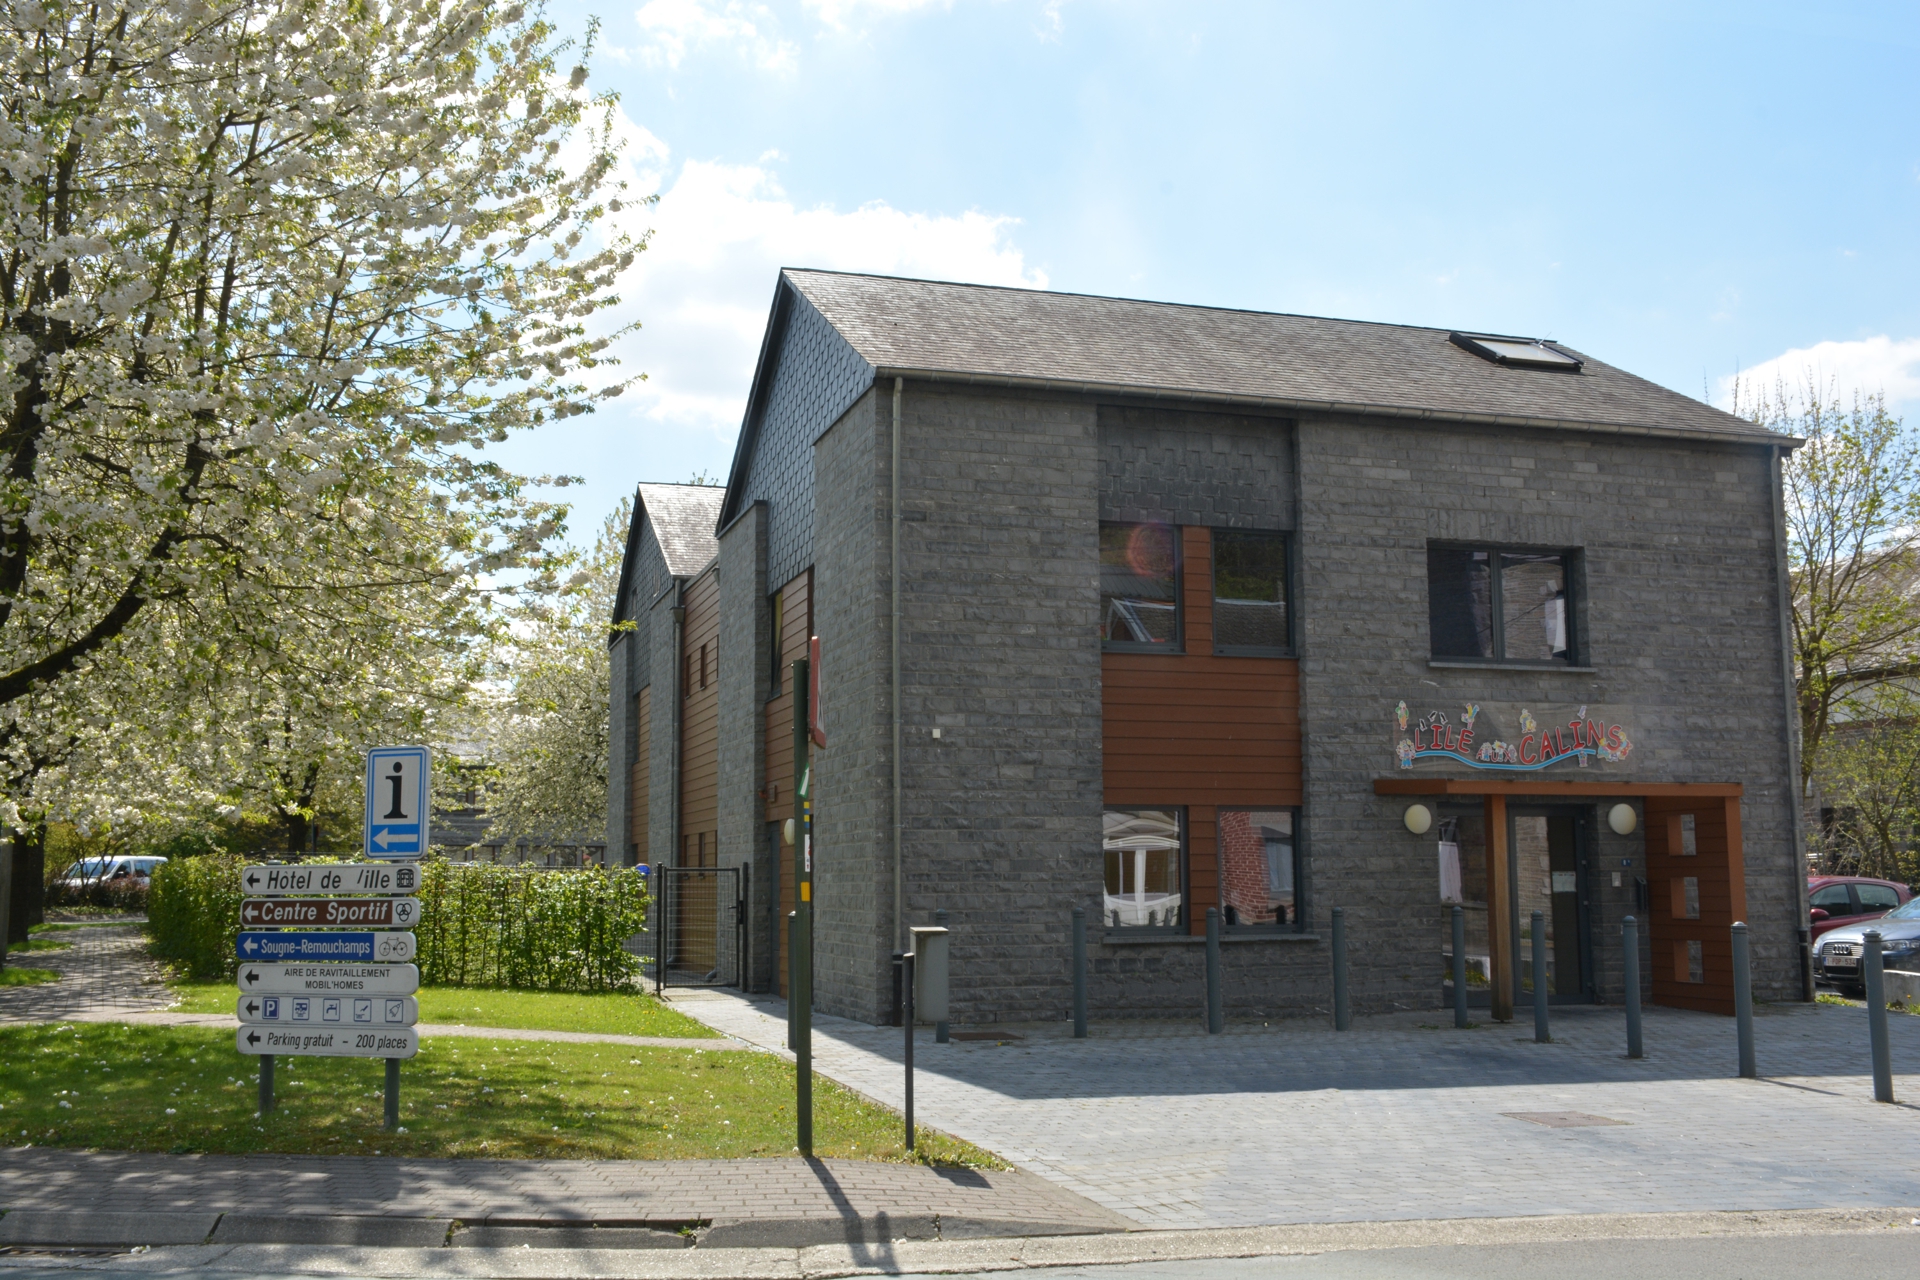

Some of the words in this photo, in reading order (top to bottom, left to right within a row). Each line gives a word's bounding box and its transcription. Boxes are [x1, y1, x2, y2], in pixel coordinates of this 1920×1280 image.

[1519, 719, 1622, 765] CALINS
[267, 869, 312, 889] Hôtel
[320, 870, 342, 889] de
[261, 902, 317, 921] Centre
[326, 901, 388, 924] Sportif
[261, 938, 371, 957] Sougne-Remouchamps
[284, 968, 303, 977] AIRE
[306, 968, 317, 977] DE
[319, 968, 391, 978] RAVITAILLEMENT
[305, 981, 364, 990] MOBIL'HOMES
[267, 1032, 301, 1050] Parking
[303, 1034, 334, 1051] gratuit
[355, 1034, 375, 1049] 200
[377, 1035, 408, 1051] places
